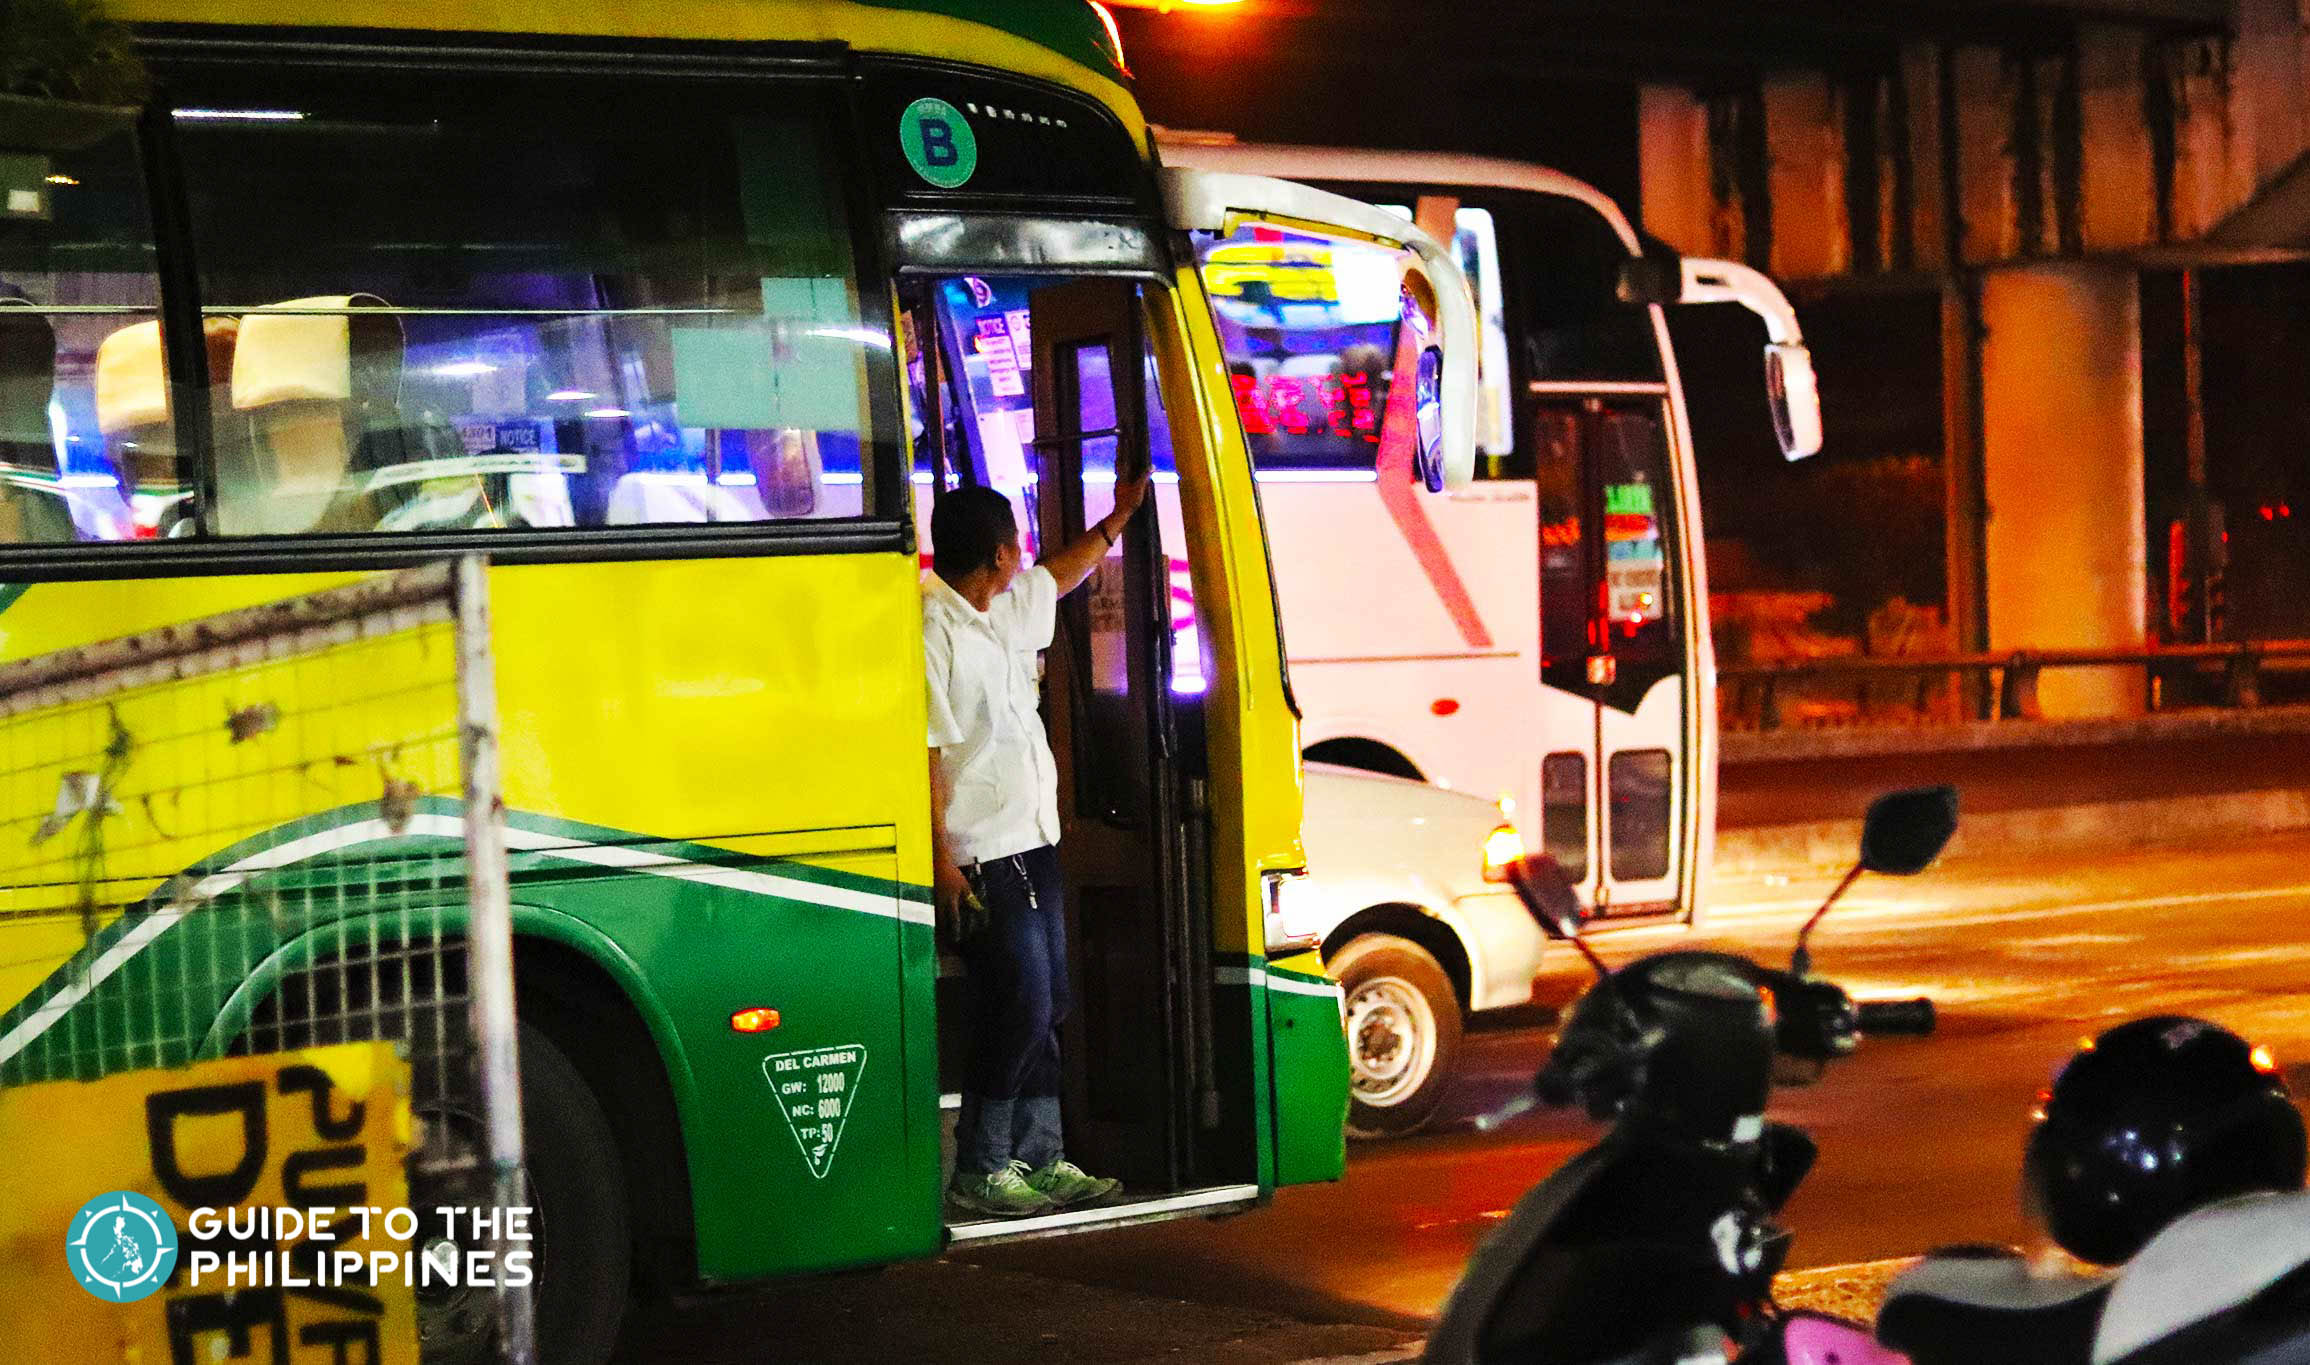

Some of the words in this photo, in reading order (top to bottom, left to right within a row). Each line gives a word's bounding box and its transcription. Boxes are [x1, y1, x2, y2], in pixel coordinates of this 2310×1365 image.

[919, 118, 959, 167] B
[775, 1058, 800, 1071] DEL
[803, 1051, 856, 1068] CARMEN
[782, 1082, 807, 1095] GW:
[817, 1072, 845, 1093] 12000
[792, 1104, 814, 1117] NC:
[818, 1097, 841, 1119] 6000
[800, 1127, 821, 1140] TP:
[821, 1122, 834, 1143] 50
